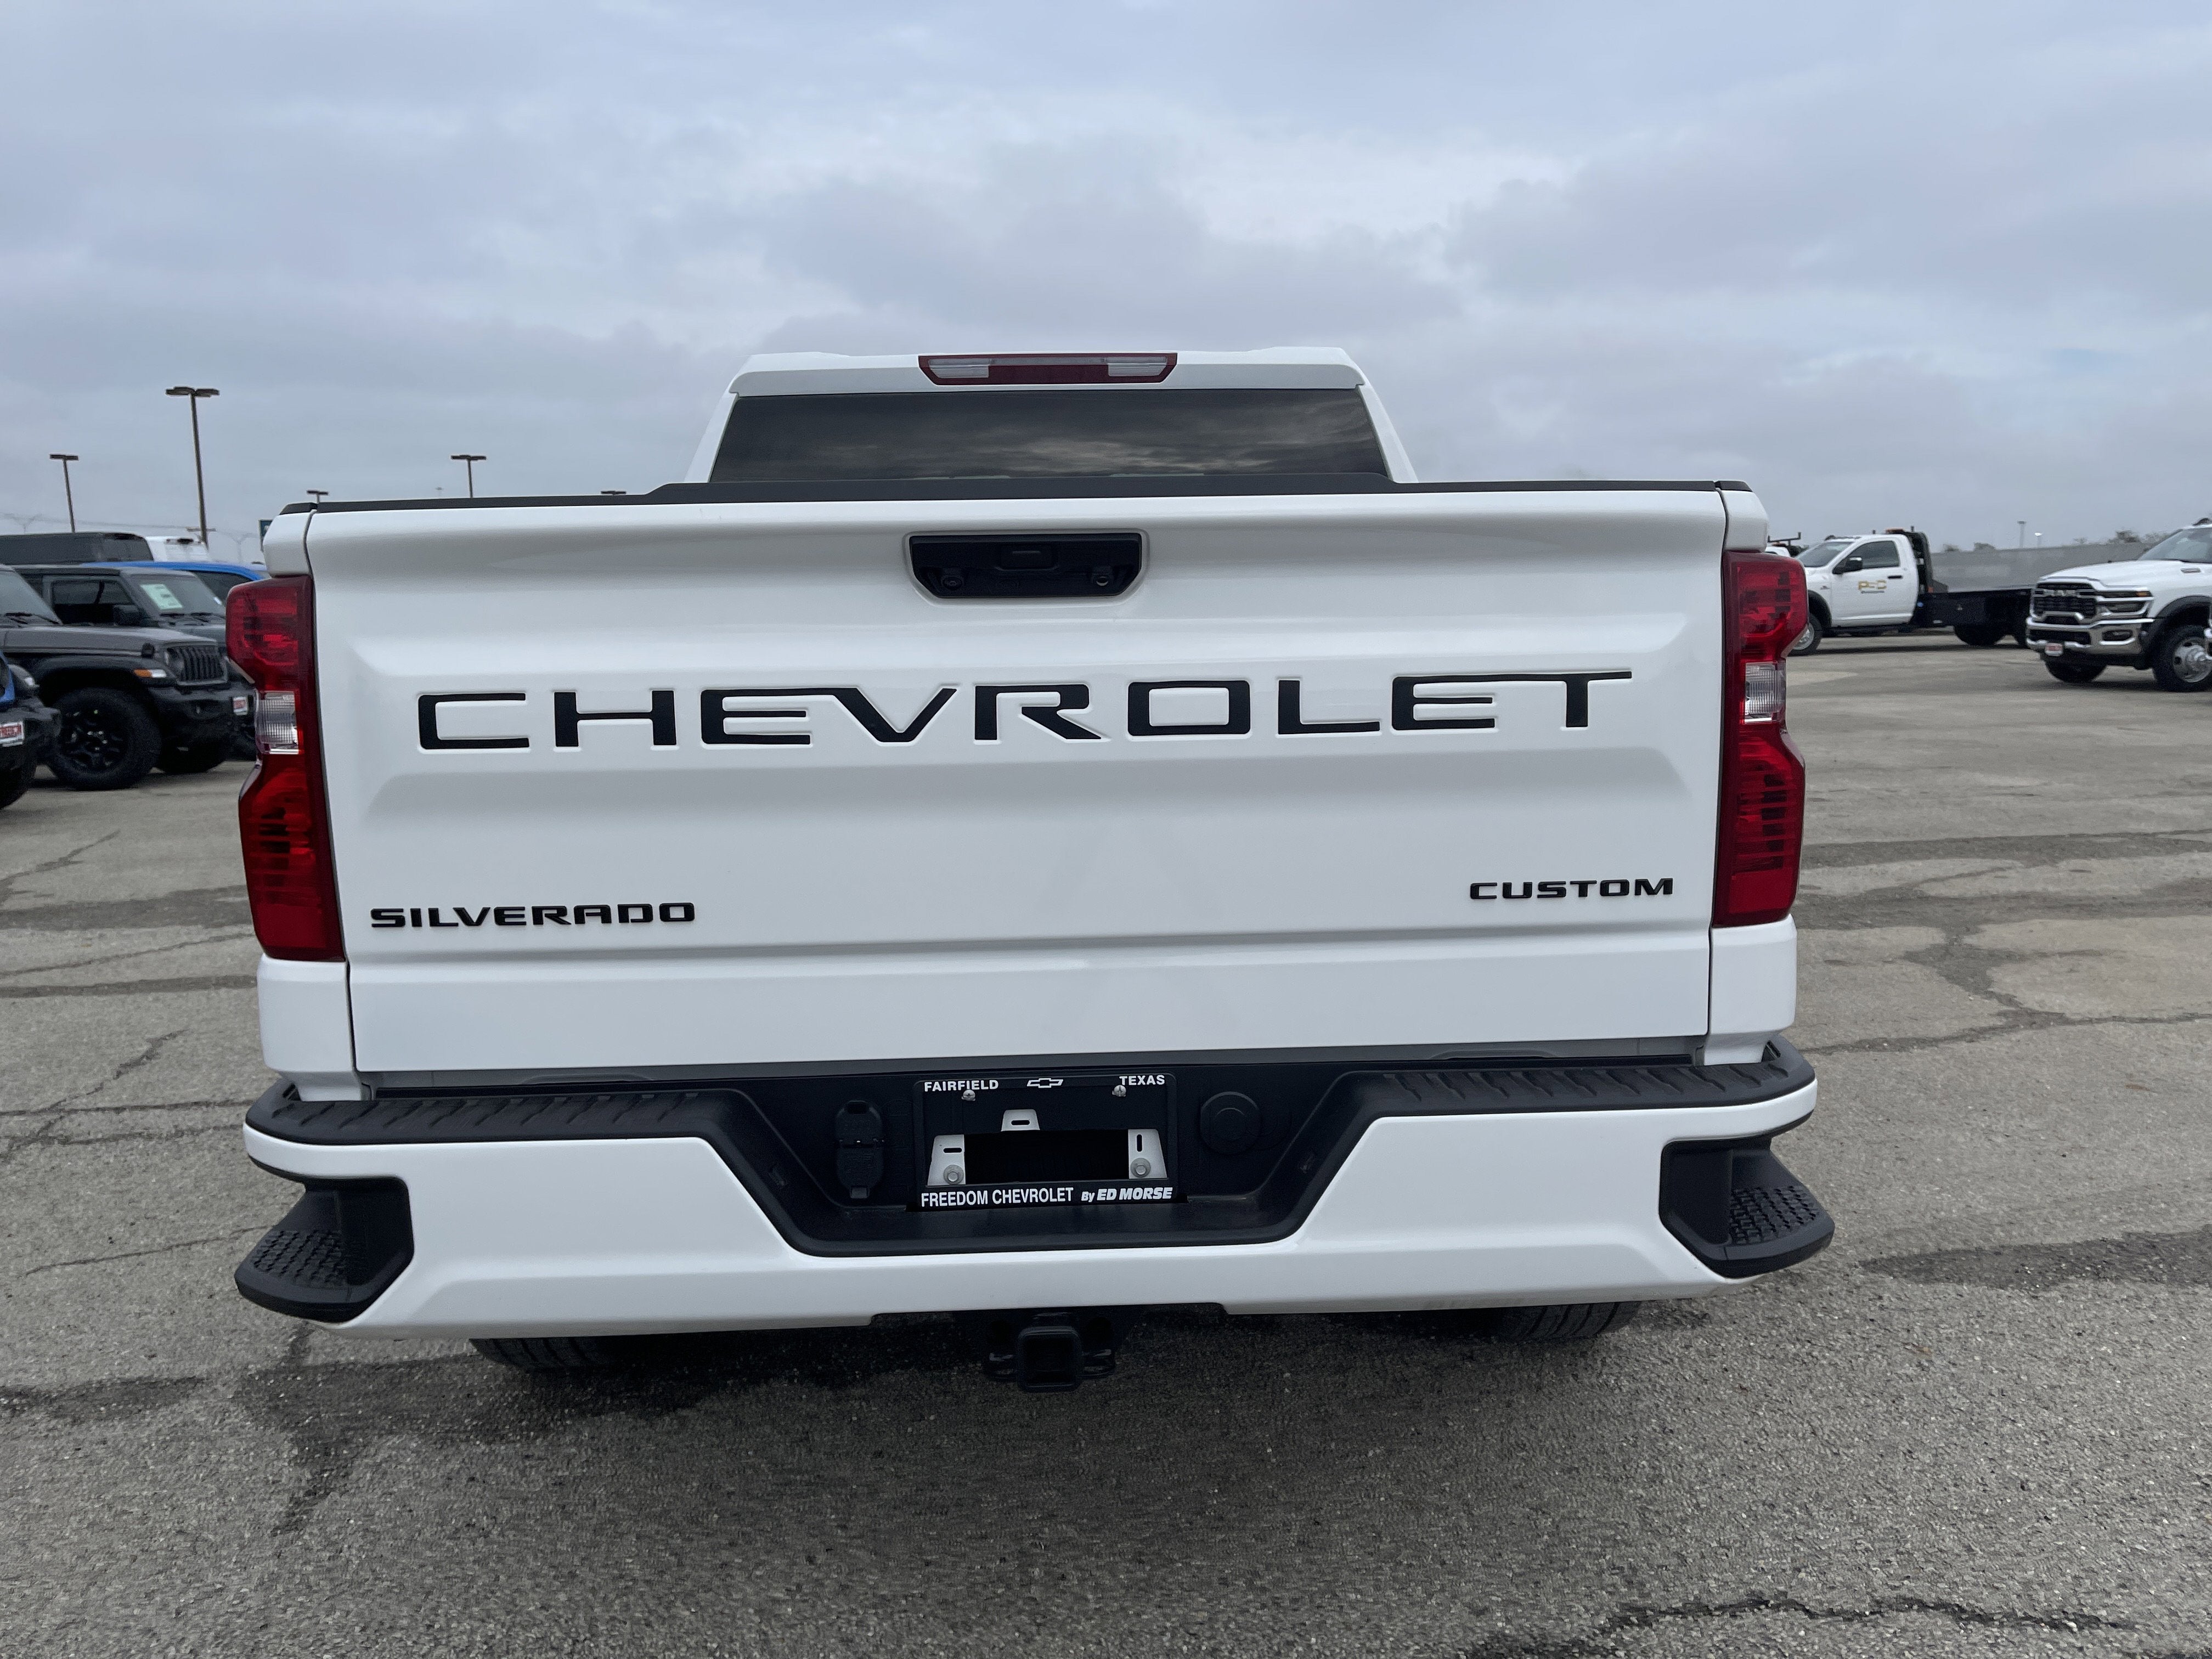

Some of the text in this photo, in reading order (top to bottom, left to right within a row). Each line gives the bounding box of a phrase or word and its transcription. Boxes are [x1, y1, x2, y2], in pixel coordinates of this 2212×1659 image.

[417, 671, 1633, 750] CHEVROLET
[1470, 878, 1673, 900] CUSTOM
[370, 902, 695, 928] SILVERADO
[924, 1080, 999, 1092] FAIRFIELD
[1119, 1074, 1165, 1086] TEXAS
[921, 1187, 1173, 1207] FREEDOM CHEVROLET By ED MORSE
